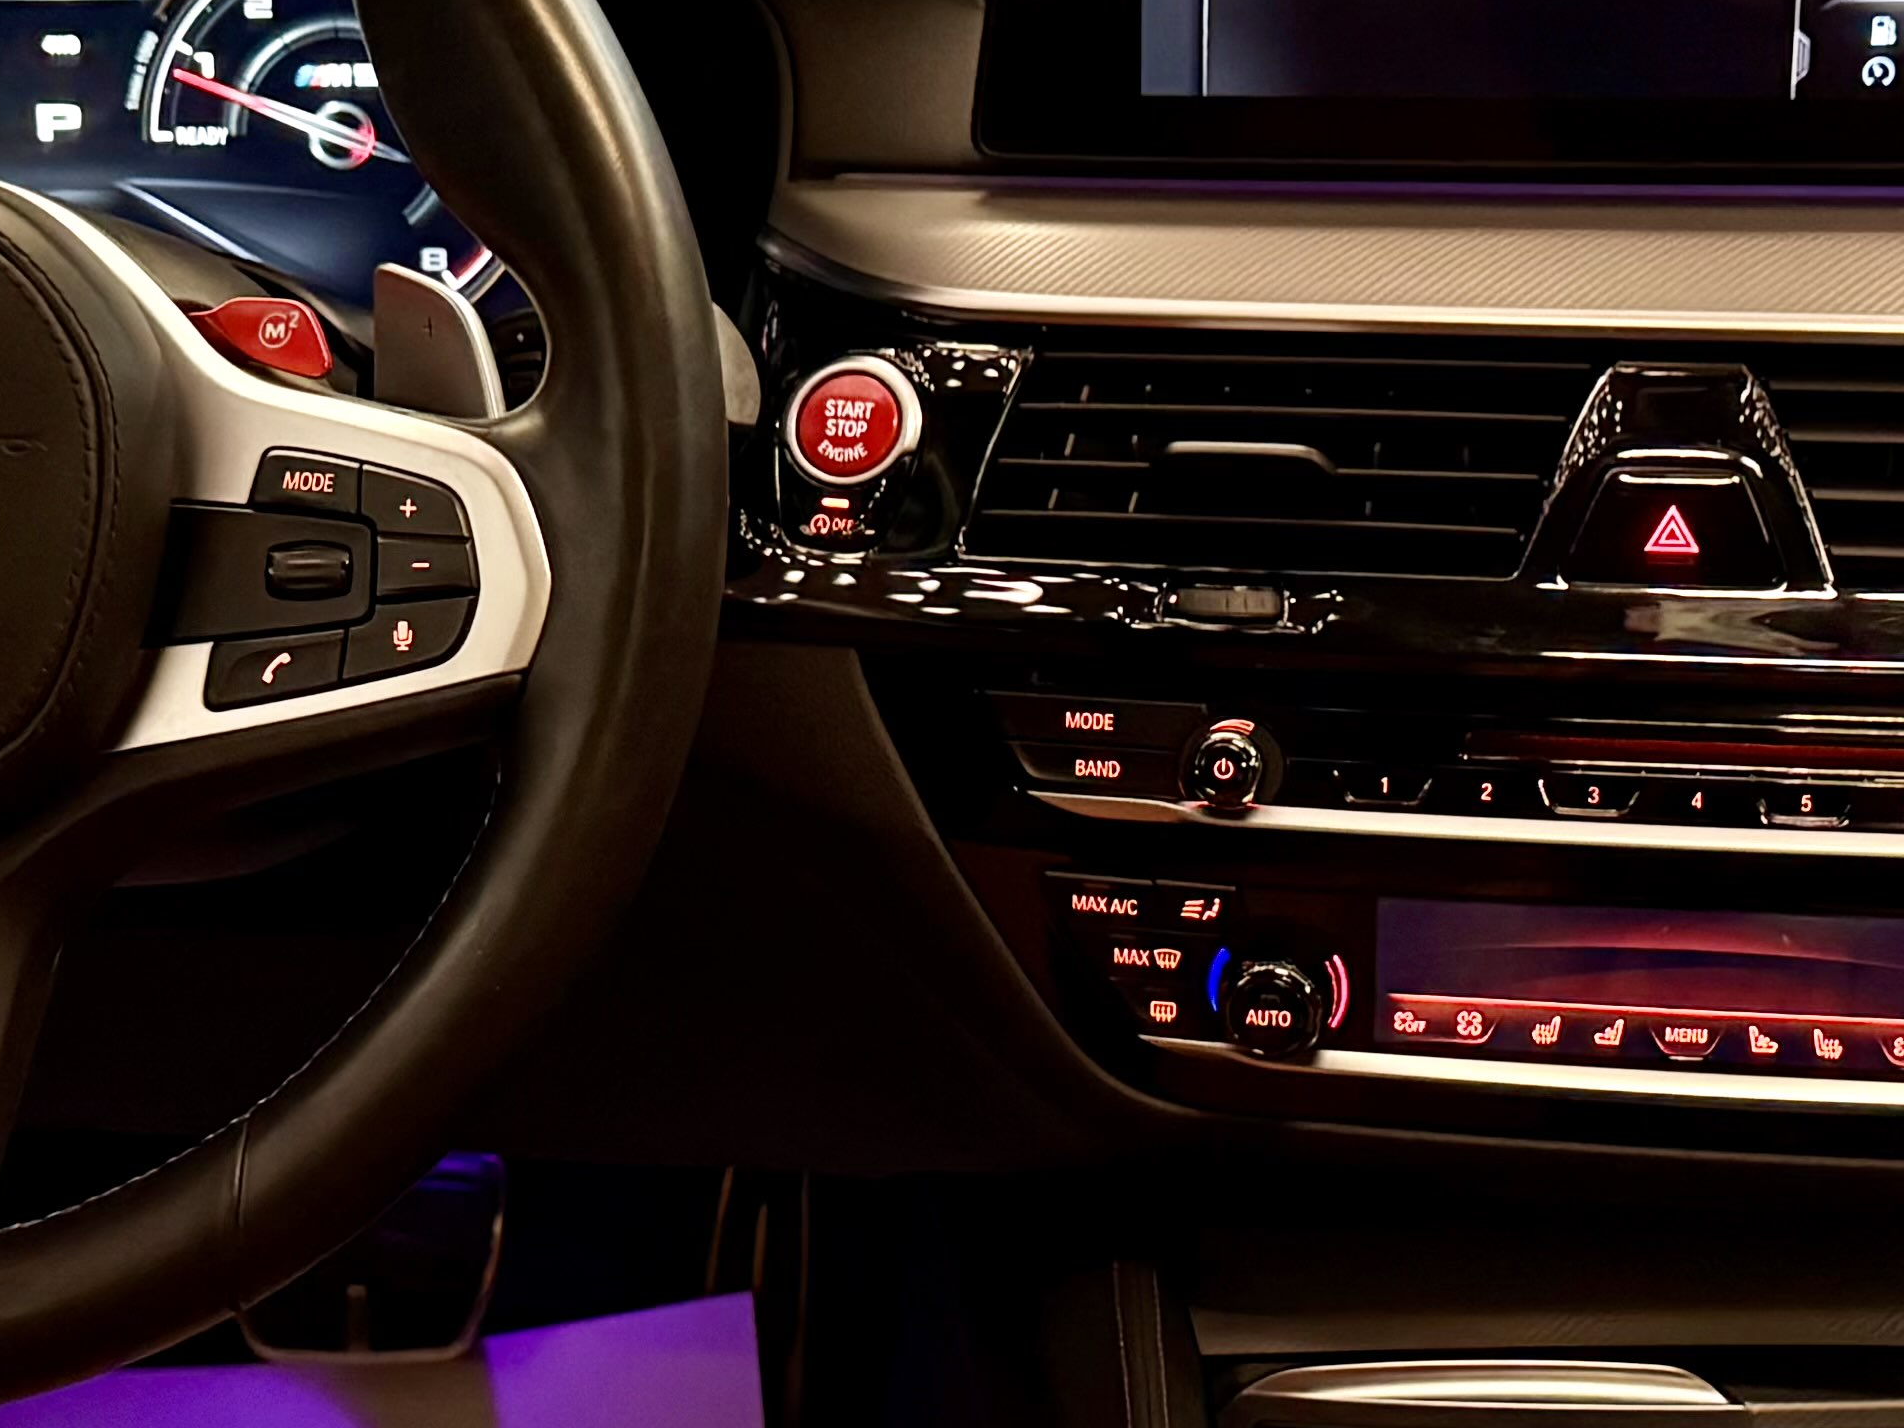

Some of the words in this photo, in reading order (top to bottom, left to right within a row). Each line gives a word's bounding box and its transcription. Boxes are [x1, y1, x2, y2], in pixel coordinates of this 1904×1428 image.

[35, 103, 82, 142] P
[175, 126, 228, 146] READY
[420, 246, 448, 272] 8
[825, 399, 875, 420] START
[826, 419, 868, 438] STOP
[817, 439, 868, 462] ENGINE
[282, 472, 335, 493] MODE
[1065, 711, 1115, 732] MODE
[1075, 758, 1122, 778] BAND
[1380, 777, 1390, 794] 1
[1481, 783, 1492, 801] 2
[1587, 787, 1600, 804] 3
[1691, 792, 1703, 810] 4
[1800, 795, 1812, 813] 5
[1071, 893, 1107, 913] MAX
[1110, 897, 1138, 915] A/C
[1113, 948, 1150, 968] MAX
[1245, 1009, 1292, 1029] AUTO
[1664, 1026, 1708, 1045] MENU
